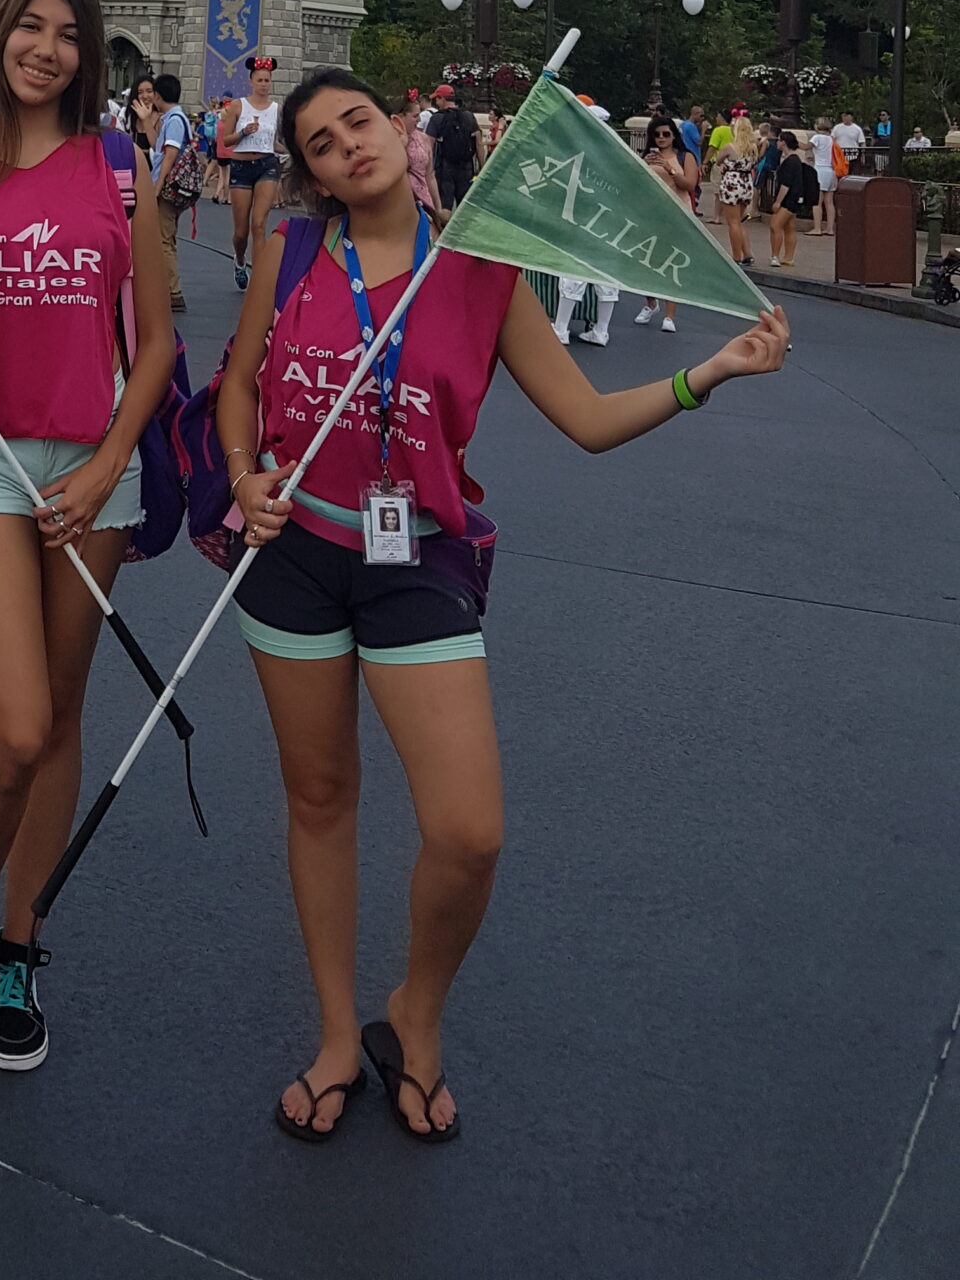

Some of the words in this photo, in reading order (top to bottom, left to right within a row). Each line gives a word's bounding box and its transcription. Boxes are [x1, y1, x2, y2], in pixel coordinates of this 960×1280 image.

[543, 151, 691, 287] ALIAR
[40, 292, 98, 308] Aventura
[306, 346, 334, 359] Con
[283, 402, 306, 421] sta
[314, 409, 353, 430] Gan
